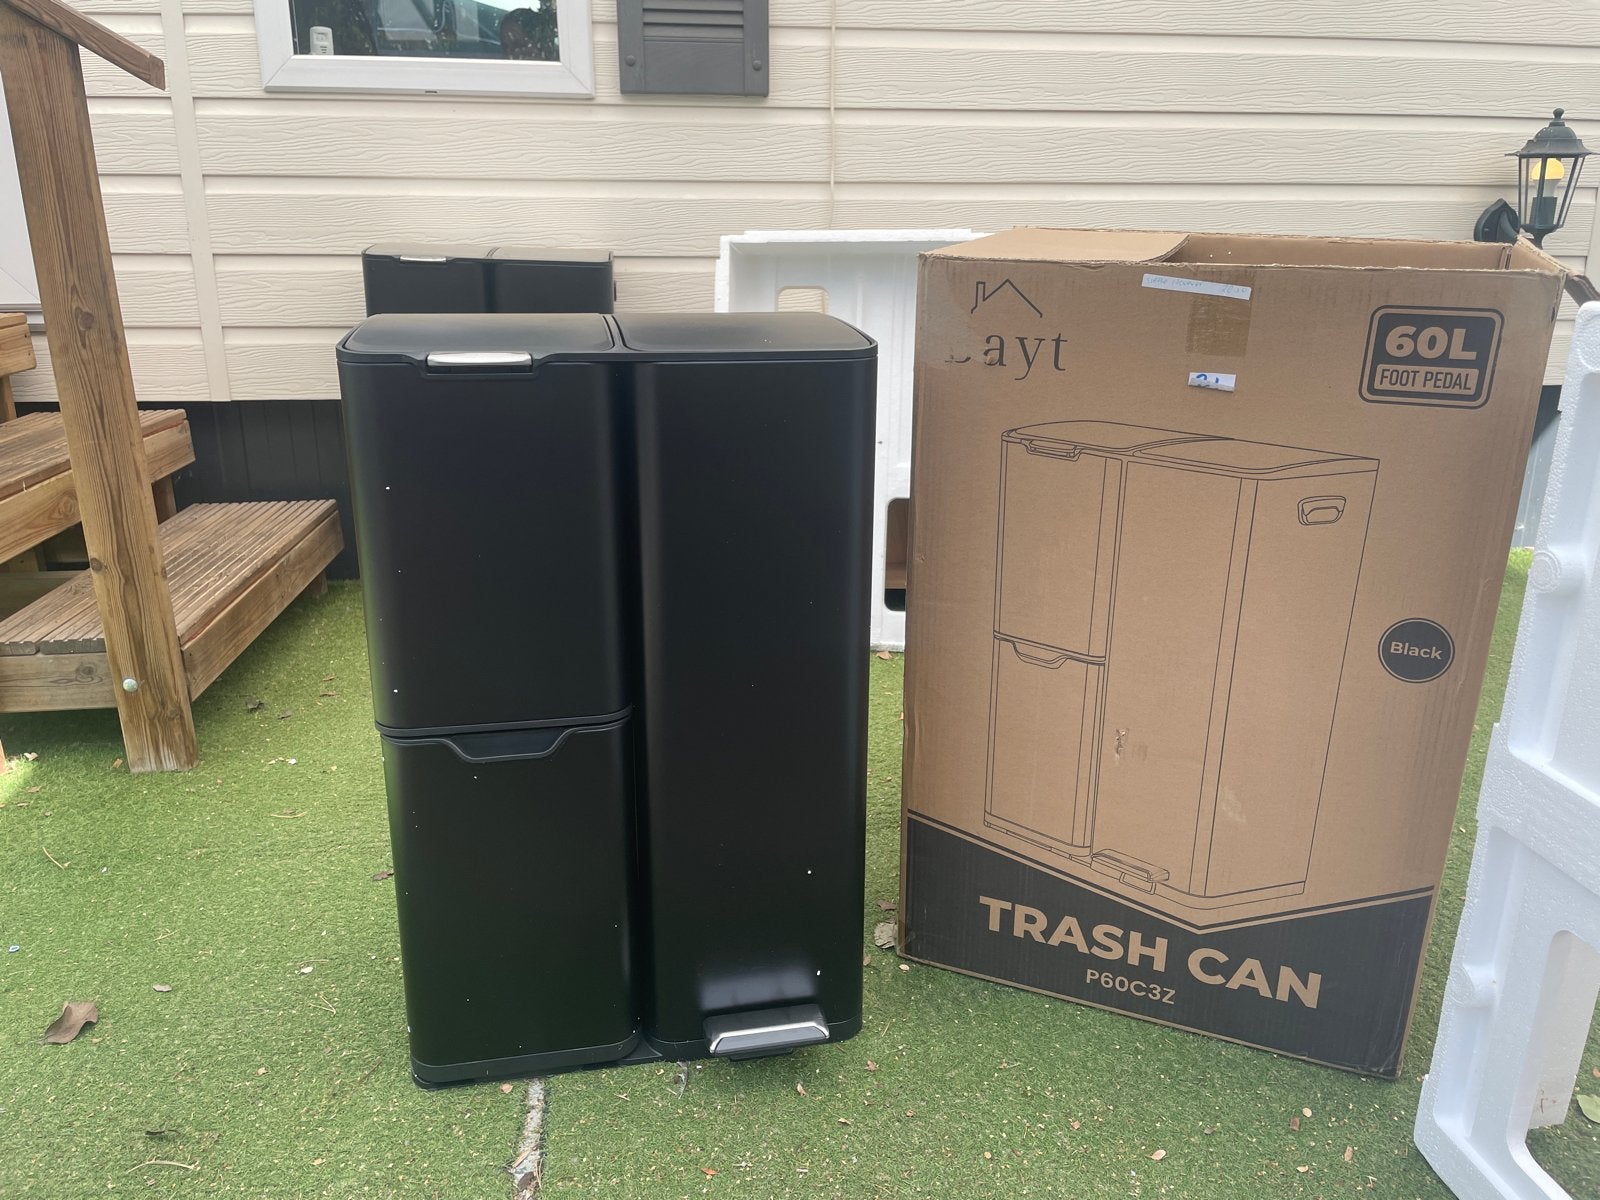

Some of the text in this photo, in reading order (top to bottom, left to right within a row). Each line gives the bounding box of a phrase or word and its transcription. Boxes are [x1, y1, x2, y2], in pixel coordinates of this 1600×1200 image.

[944, 332, 1068, 381] ayt
[1385, 325, 1478, 361] 60L
[1379, 368, 1472, 391] FOOT PEDAL
[1390, 641, 1443, 660] Black
[979, 895, 1322, 1009] TRASH CAN
[1086, 968, 1176, 1005] P60C3Z
